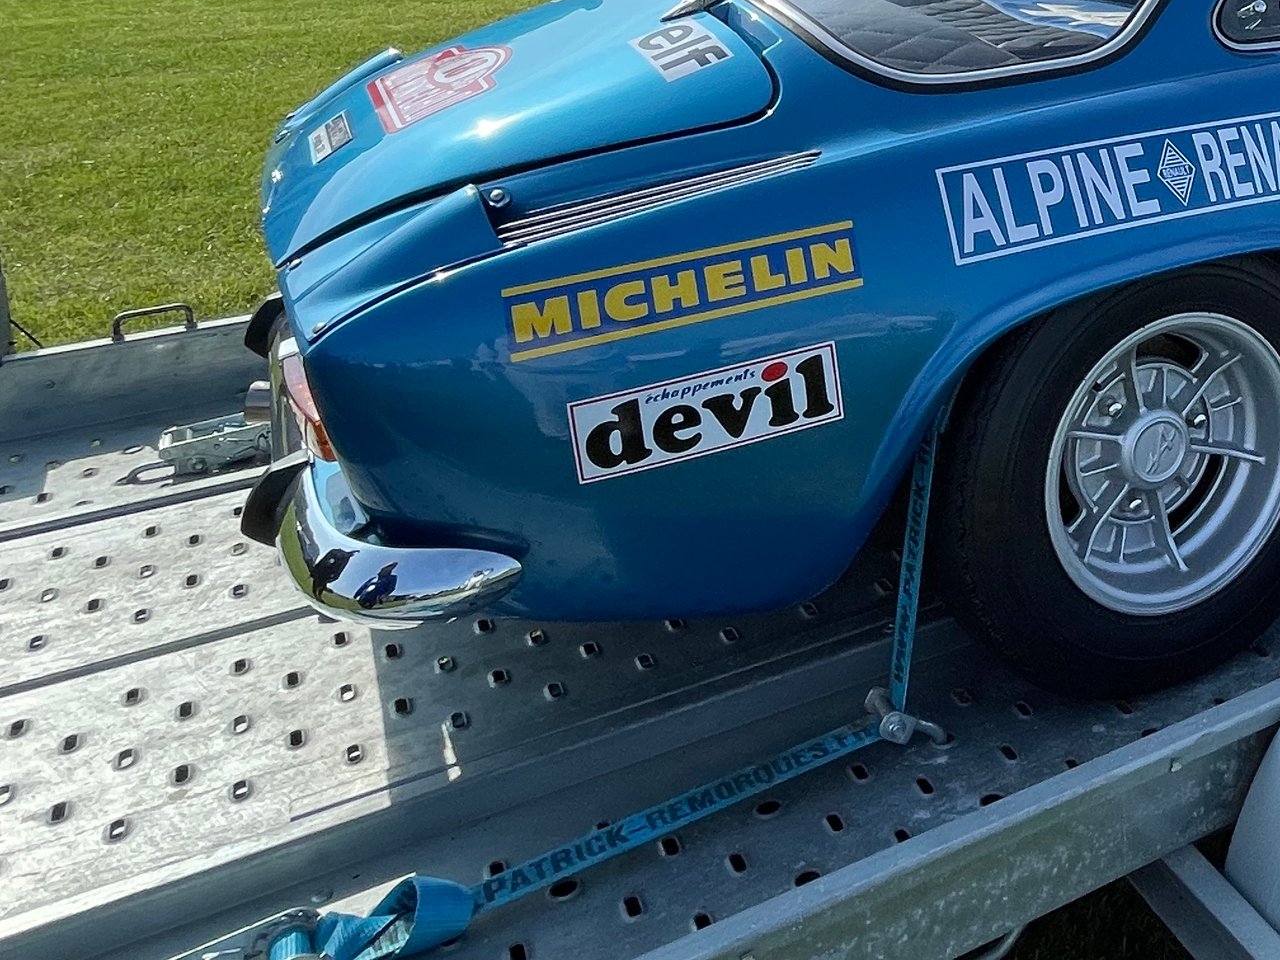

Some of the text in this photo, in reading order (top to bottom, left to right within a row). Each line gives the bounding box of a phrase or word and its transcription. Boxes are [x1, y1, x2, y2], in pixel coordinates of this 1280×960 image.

[637, 24, 730, 72] elf
[962, 139, 1161, 253] ALPINE
[511, 238, 855, 344] MICHELIN
[585, 353, 836, 470] devil
[644, 368, 757, 405] échappements
